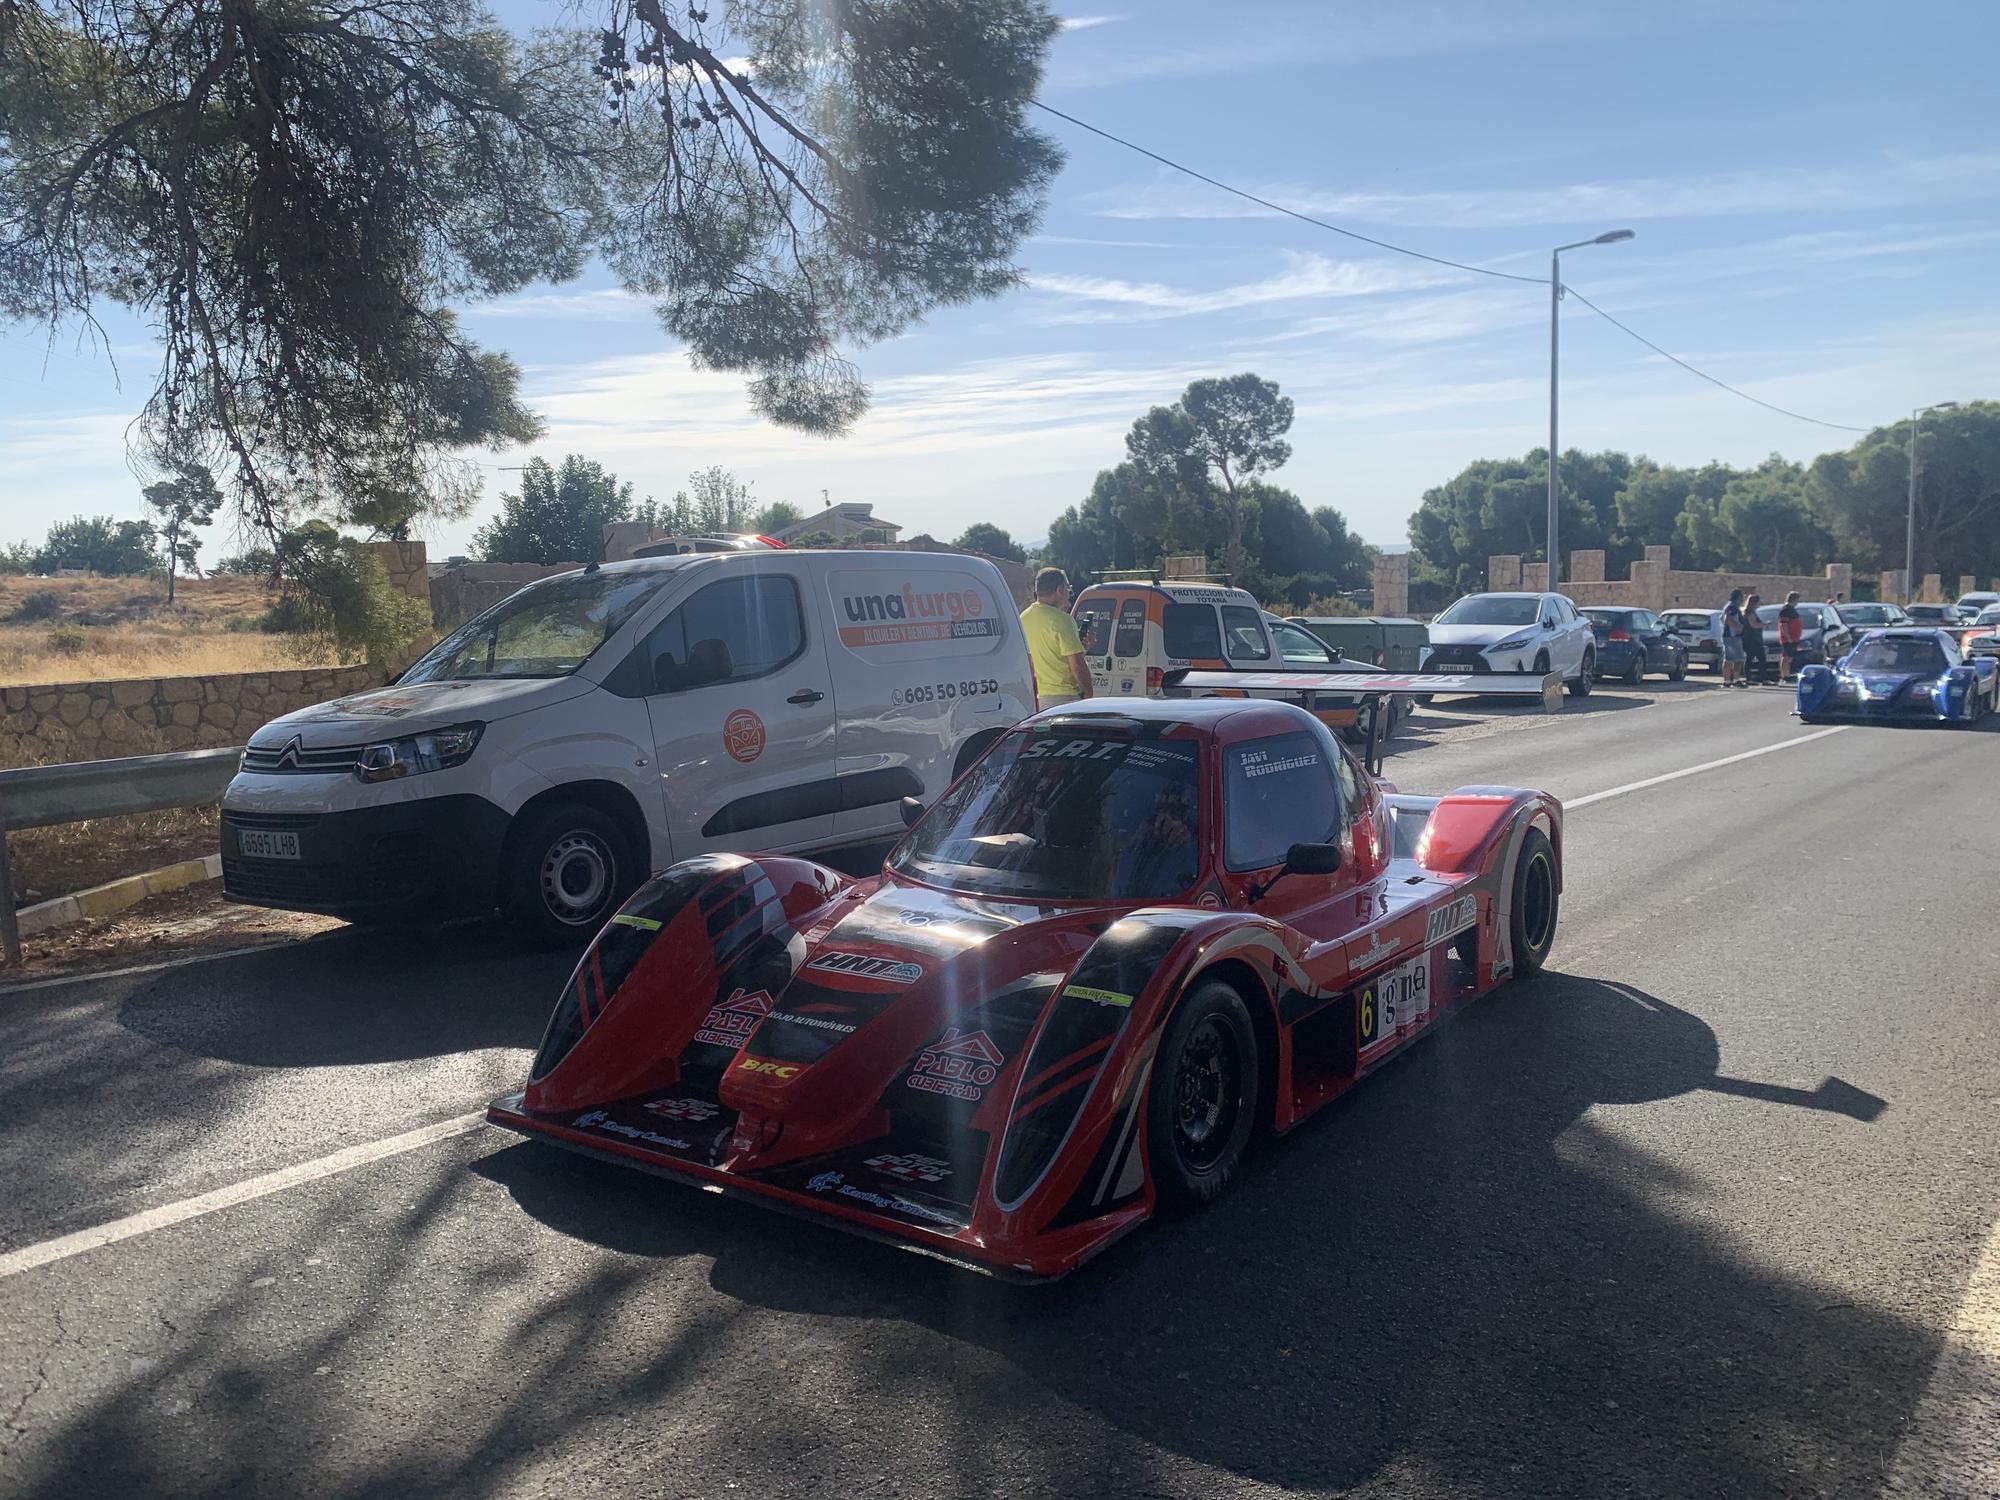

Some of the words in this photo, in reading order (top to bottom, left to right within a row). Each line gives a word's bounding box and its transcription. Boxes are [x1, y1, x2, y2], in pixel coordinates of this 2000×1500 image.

[1225, 590, 1245, 599] CIVIL
[864, 628, 900, 644] ALQUILER
[900, 627, 907, 641] Y
[908, 625, 939, 640] RENTING
[940, 624, 951, 637] DE
[1324, 673, 1473, 683] MOTOR
[905, 685, 934, 703] 605
[937, 683, 956, 700] 50
[960, 680, 978, 696] 80
[980, 678, 998, 694] 50
[1018, 739, 1127, 760] S.R.T.
[273, 834, 297, 856] LHB
[1427, 897, 1465, 943] HNT
[814, 952, 904, 975] HNT
[701, 1010, 760, 1035] PABL
[767, 1011, 794, 1023] ROJO
[1361, 990, 1373, 1037] 6
[738, 1058, 799, 1078] BRC
[914, 1052, 996, 1085] PABLO
[907, 1074, 981, 1101] CUBIERTAS
[875, 1154, 953, 1176] MOTOR
[902, 1153, 951, 1166] PEP
[836, 1184, 893, 1208] Karting
